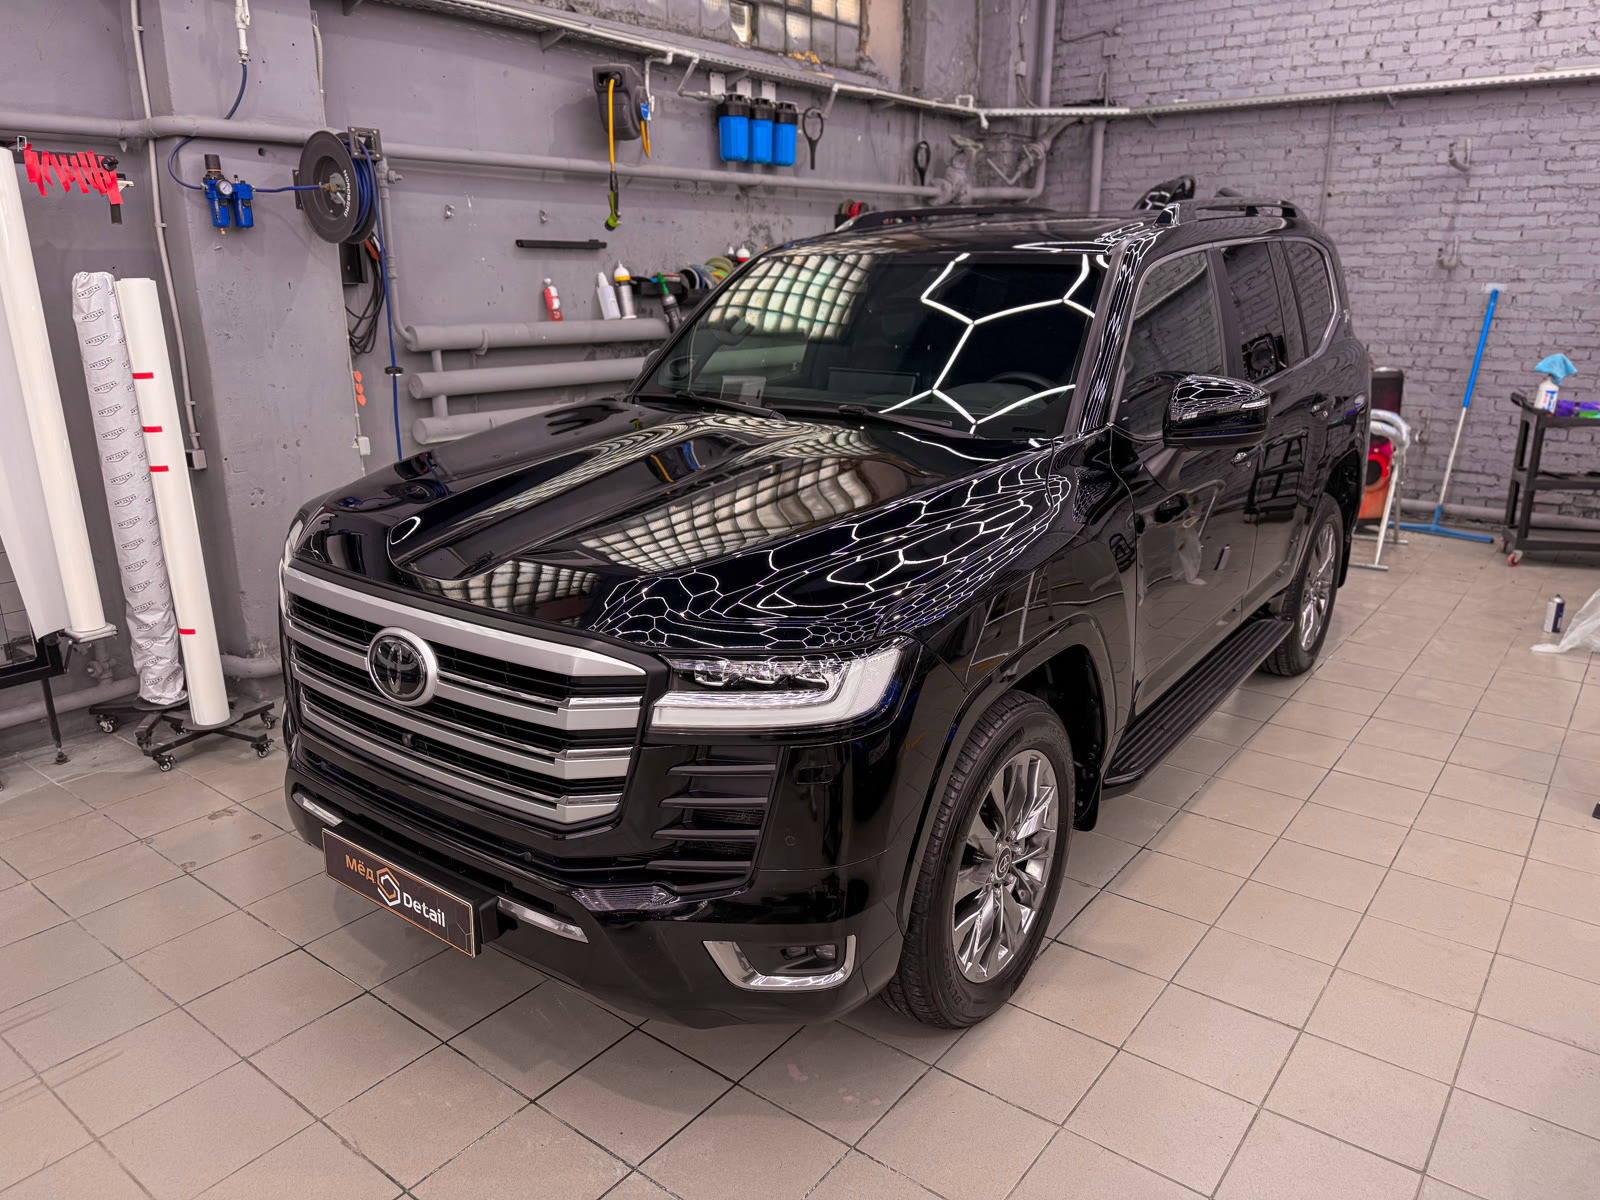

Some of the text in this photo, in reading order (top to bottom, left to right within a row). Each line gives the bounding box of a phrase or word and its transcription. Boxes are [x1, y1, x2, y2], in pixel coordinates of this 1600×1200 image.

[342, 169, 351, 218] NORDBERG
[345, 854, 446, 928] Мёд Detail
